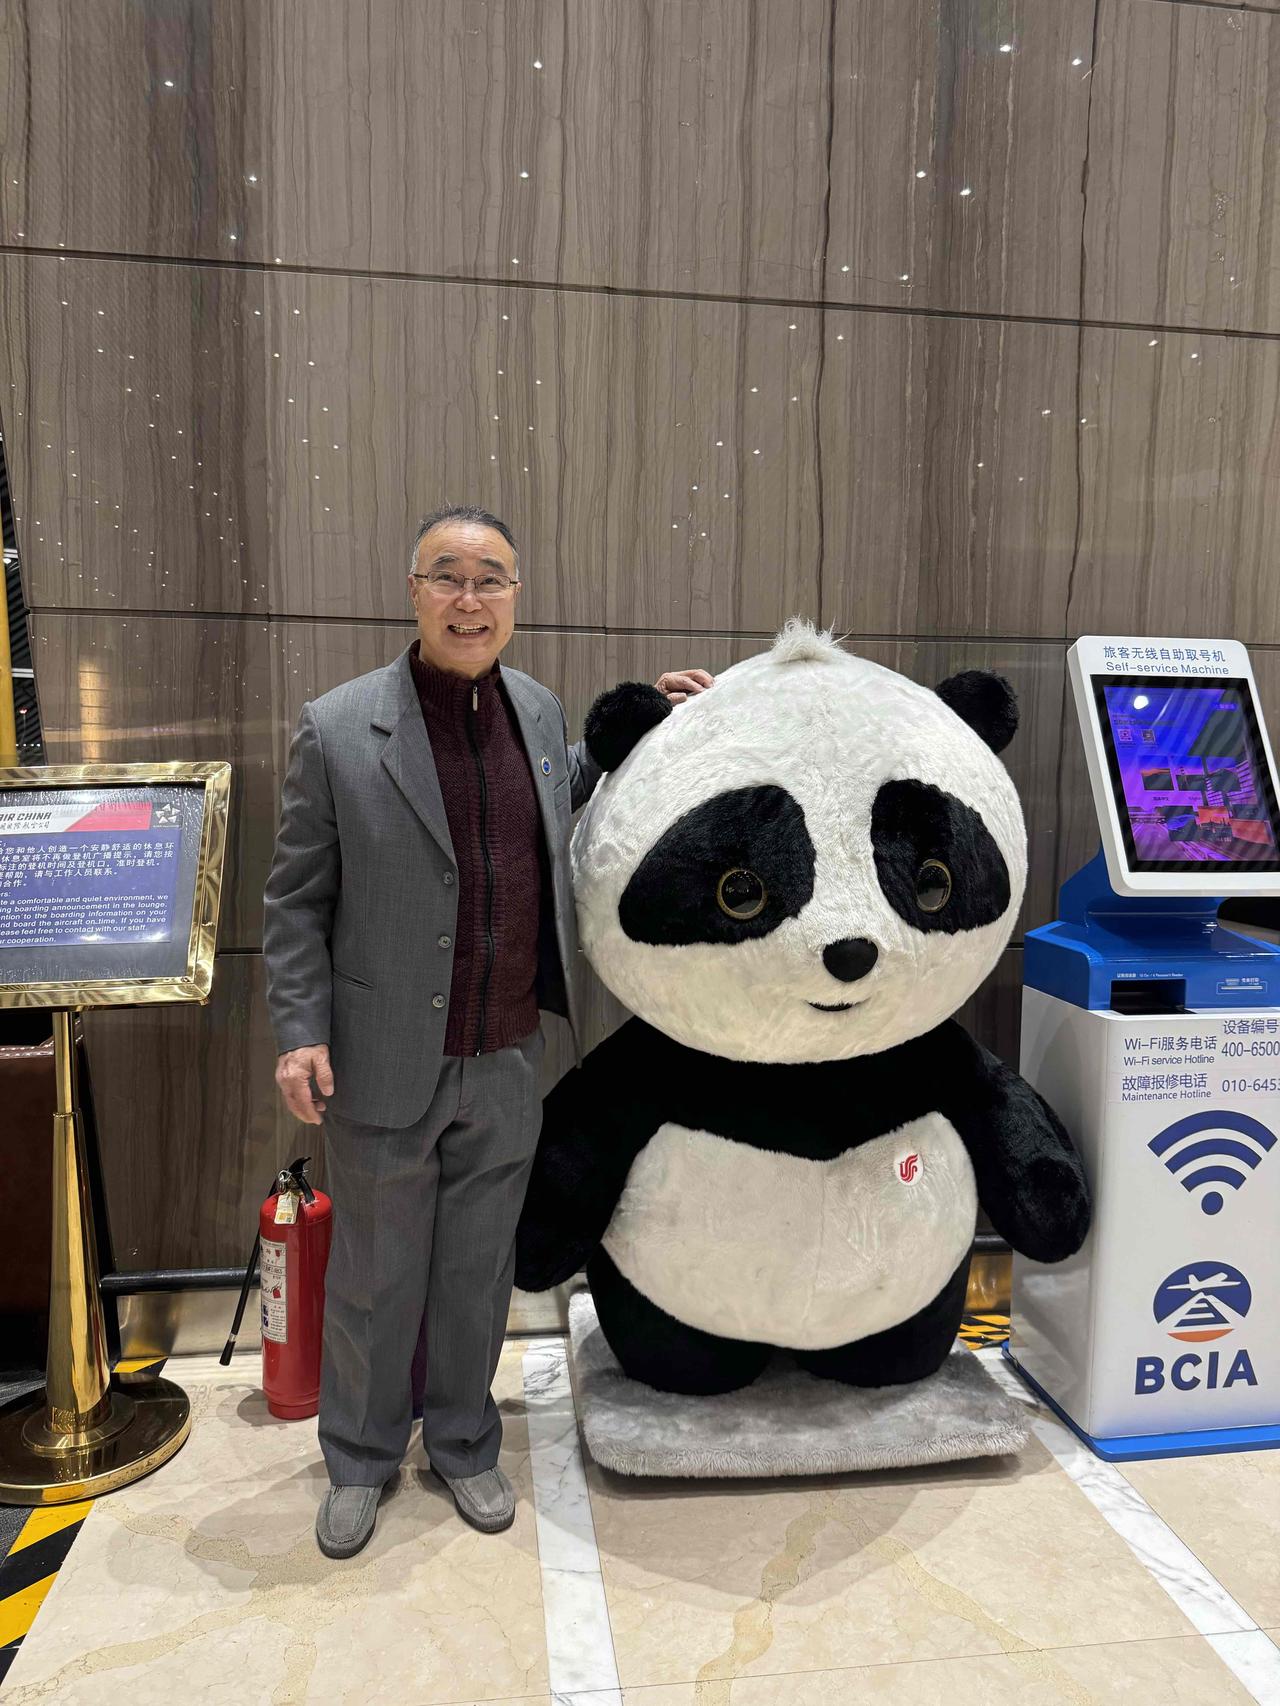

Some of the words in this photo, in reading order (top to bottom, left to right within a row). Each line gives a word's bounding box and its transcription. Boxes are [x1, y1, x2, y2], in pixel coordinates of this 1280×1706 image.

[1103, 646, 1226, 662] 旅客无线自助取号机
[1106, 661, 1178, 673] Self-service
[1180, 664, 1230, 675] Machine
[17, 812, 52, 820] CHINA
[0, 879, 27, 888] 合作。
[17, 897, 63, 905] comfortable
[1223, 1019, 1280, 1034] 设备编号
[1124, 1036, 1217, 1051] Wi-Fi服务电话
[1221, 1041, 1280, 1057] 400-6500
[1123, 1056, 1150, 1066] Wi-Fi
[1151, 1055, 1182, 1065] service
[1184, 1054, 1215, 1064] Hotline
[1122, 1073, 1208, 1091] 故障报修电话
[1121, 1091, 1178, 1101] Maintenance
[1180, 1089, 1212, 1099] Hotline
[1135, 1349, 1258, 1395] BCIA
